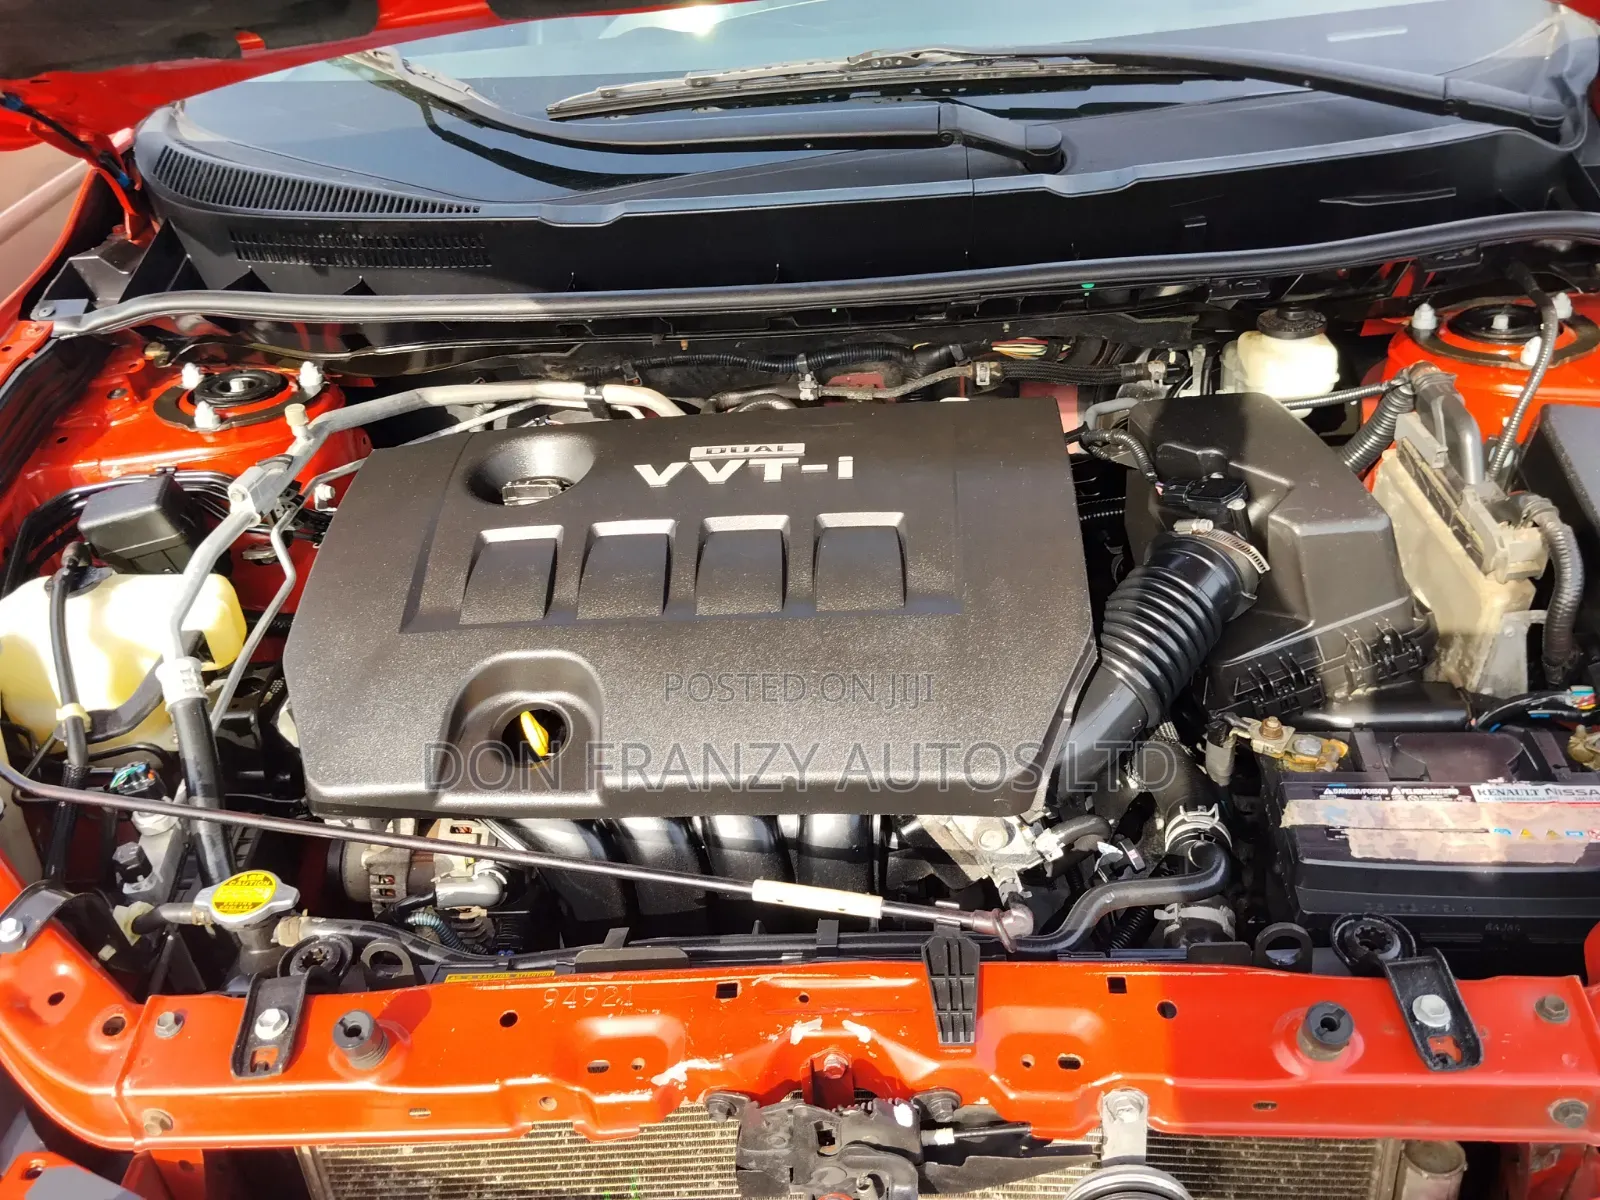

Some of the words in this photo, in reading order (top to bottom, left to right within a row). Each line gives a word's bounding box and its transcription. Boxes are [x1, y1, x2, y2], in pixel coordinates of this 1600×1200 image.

[704, 443, 797, 456] DUAL
[634, 456, 853, 487] VVT-i
[1477, 788, 1541, 796] RENAULT
